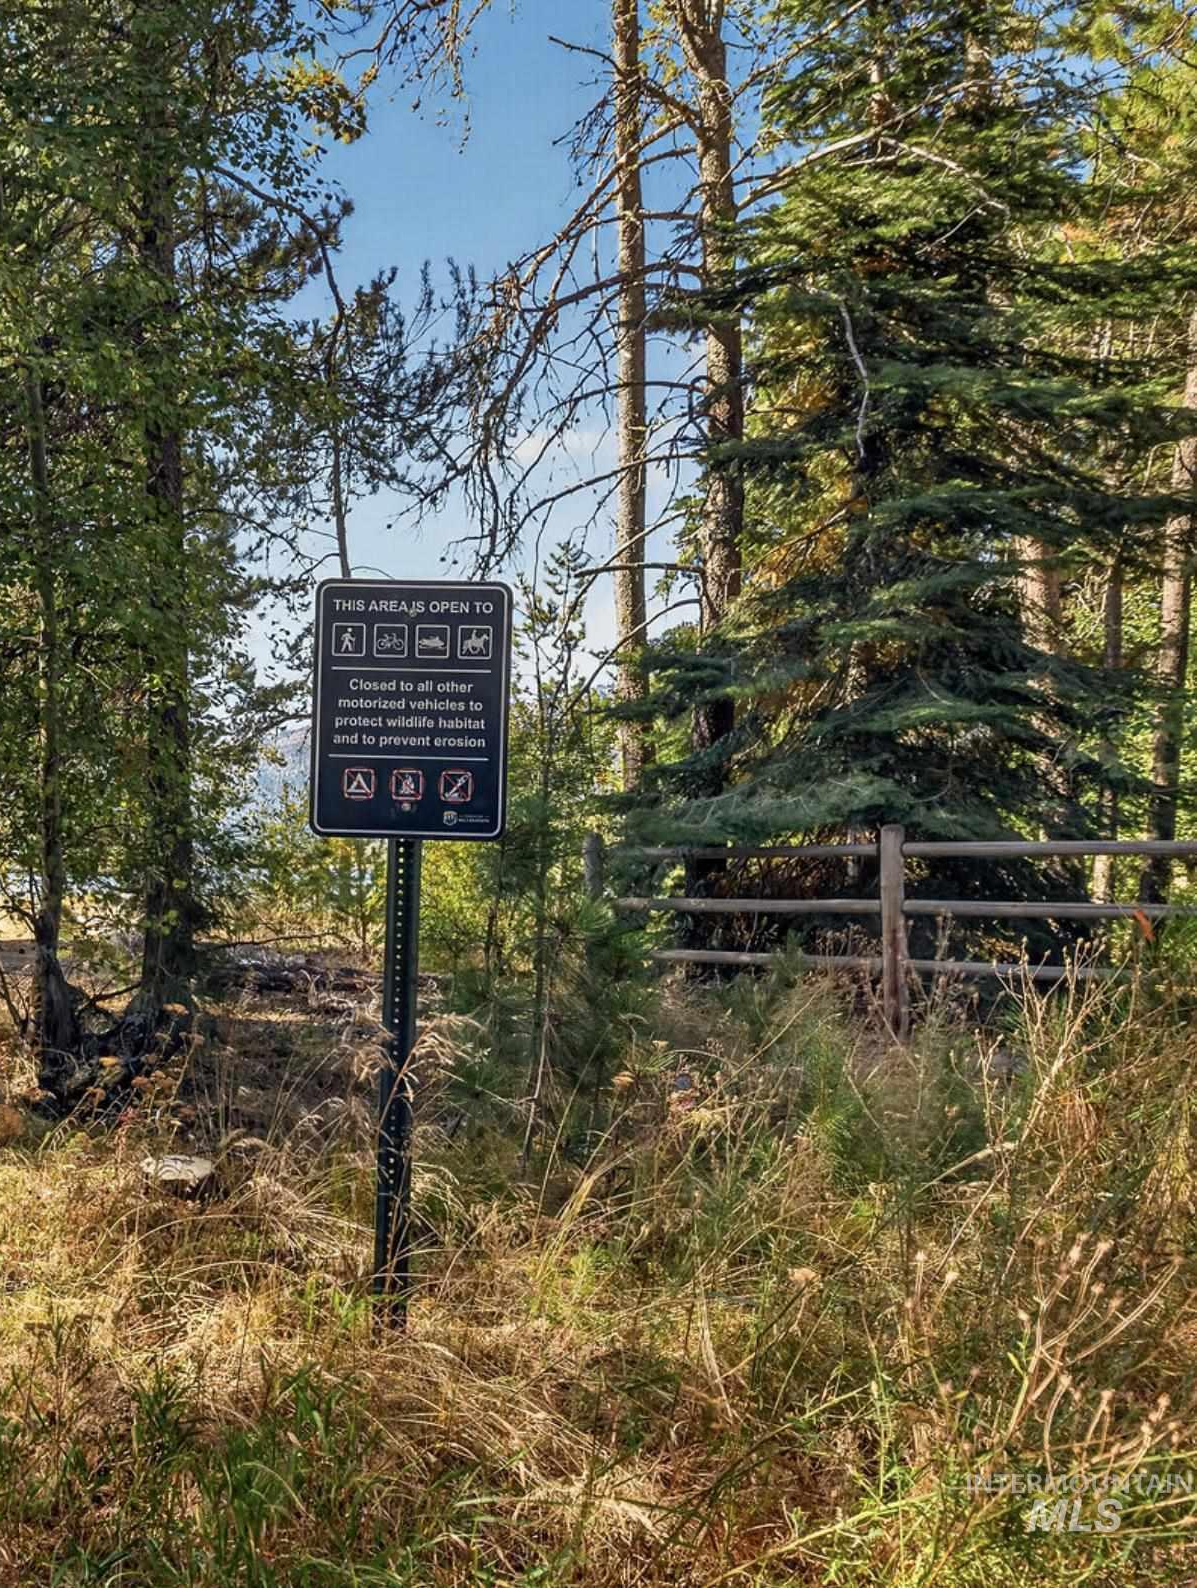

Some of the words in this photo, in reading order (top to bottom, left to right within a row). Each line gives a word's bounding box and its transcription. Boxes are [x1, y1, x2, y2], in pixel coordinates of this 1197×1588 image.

[333, 599, 365, 612] THIS
[368, 600, 408, 612] AREA
[412, 601, 425, 613] IS
[429, 602, 470, 614] OPEN
[474, 602, 493, 614] TO
[349, 678, 396, 692] Closed
[400, 680, 413, 692] to
[417, 680, 433, 693] all
[436, 680, 473, 693] other
[338, 697, 405, 710] motorized
[409, 699, 465, 711] vehicles
[469, 700, 483, 712] to
[335, 716, 383, 729] protect
[386, 716, 434, 729] wildlife
[438, 717, 485, 730] habitat
[333, 733, 359, 745] and
[362, 734, 375, 745] to
[379, 735, 431, 748] prevent
[434, 736, 486, 748] erosion
